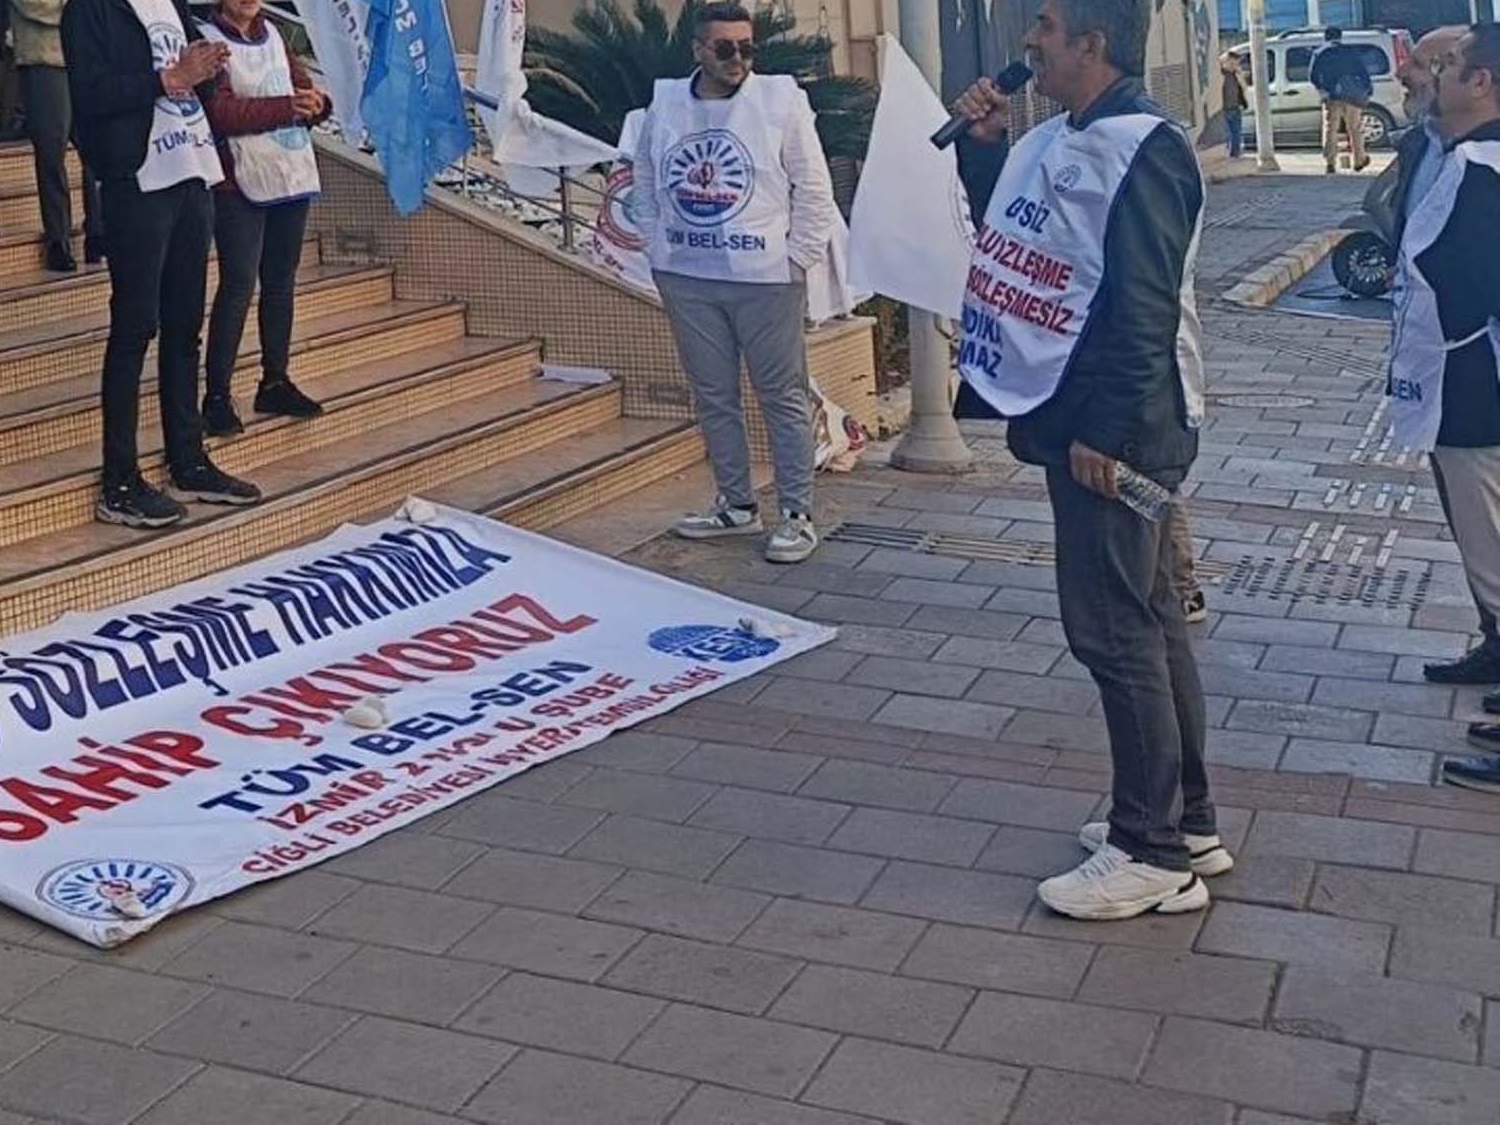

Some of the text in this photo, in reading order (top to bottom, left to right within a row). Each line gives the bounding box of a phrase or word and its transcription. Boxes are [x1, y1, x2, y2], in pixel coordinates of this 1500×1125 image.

[688, 232, 765, 251] BEL-SEN
[243, 524, 512, 646] HAKKIMIZA
[197, 659, 594, 813] TÜM BEL-SEN
[199, 591, 599, 747] ÇIKIYORUZ
[241, 832, 337, 875] ÇİĞLİ
[325, 763, 496, 836] BELEDİYESİ
[255, 769, 397, 831] İZMİR
[530, 672, 634, 718] ŞUBE
